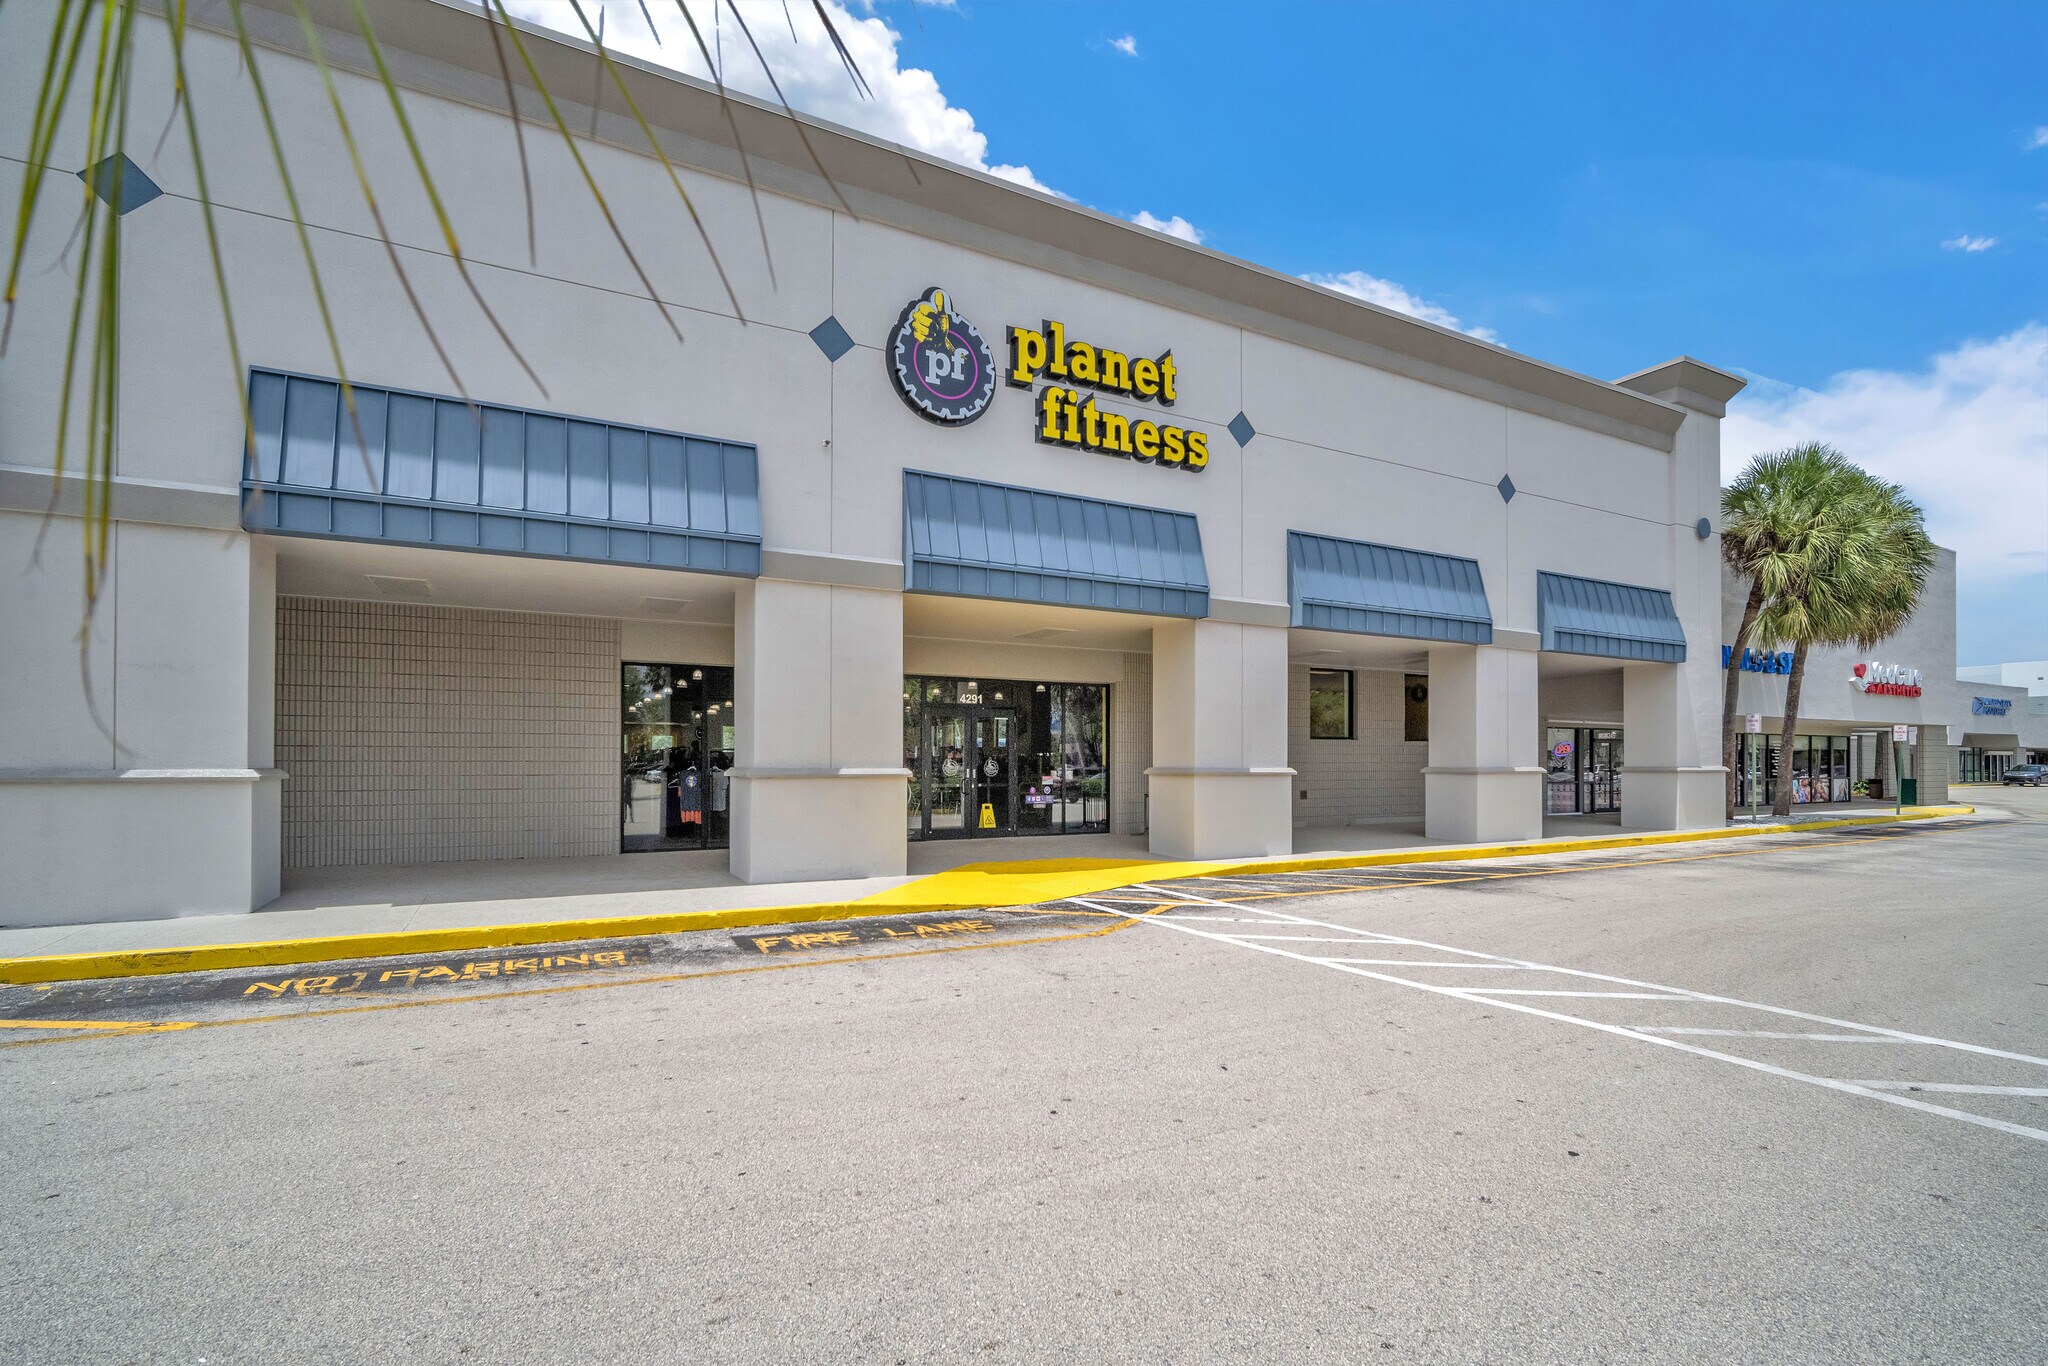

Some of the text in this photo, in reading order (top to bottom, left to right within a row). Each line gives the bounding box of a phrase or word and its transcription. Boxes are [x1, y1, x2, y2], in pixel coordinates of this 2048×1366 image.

[924, 346, 969, 386] pf
[1006, 319, 1178, 406] planet
[1036, 385, 1209, 472] fitness
[959, 693, 983, 704] 4291
[1876, 683, 1922, 698] AESTHETICS
[1555, 745, 1571, 754] OPEN
[751, 919, 996, 954] FIRE LANE
[243, 950, 628, 997] NO PARKING
